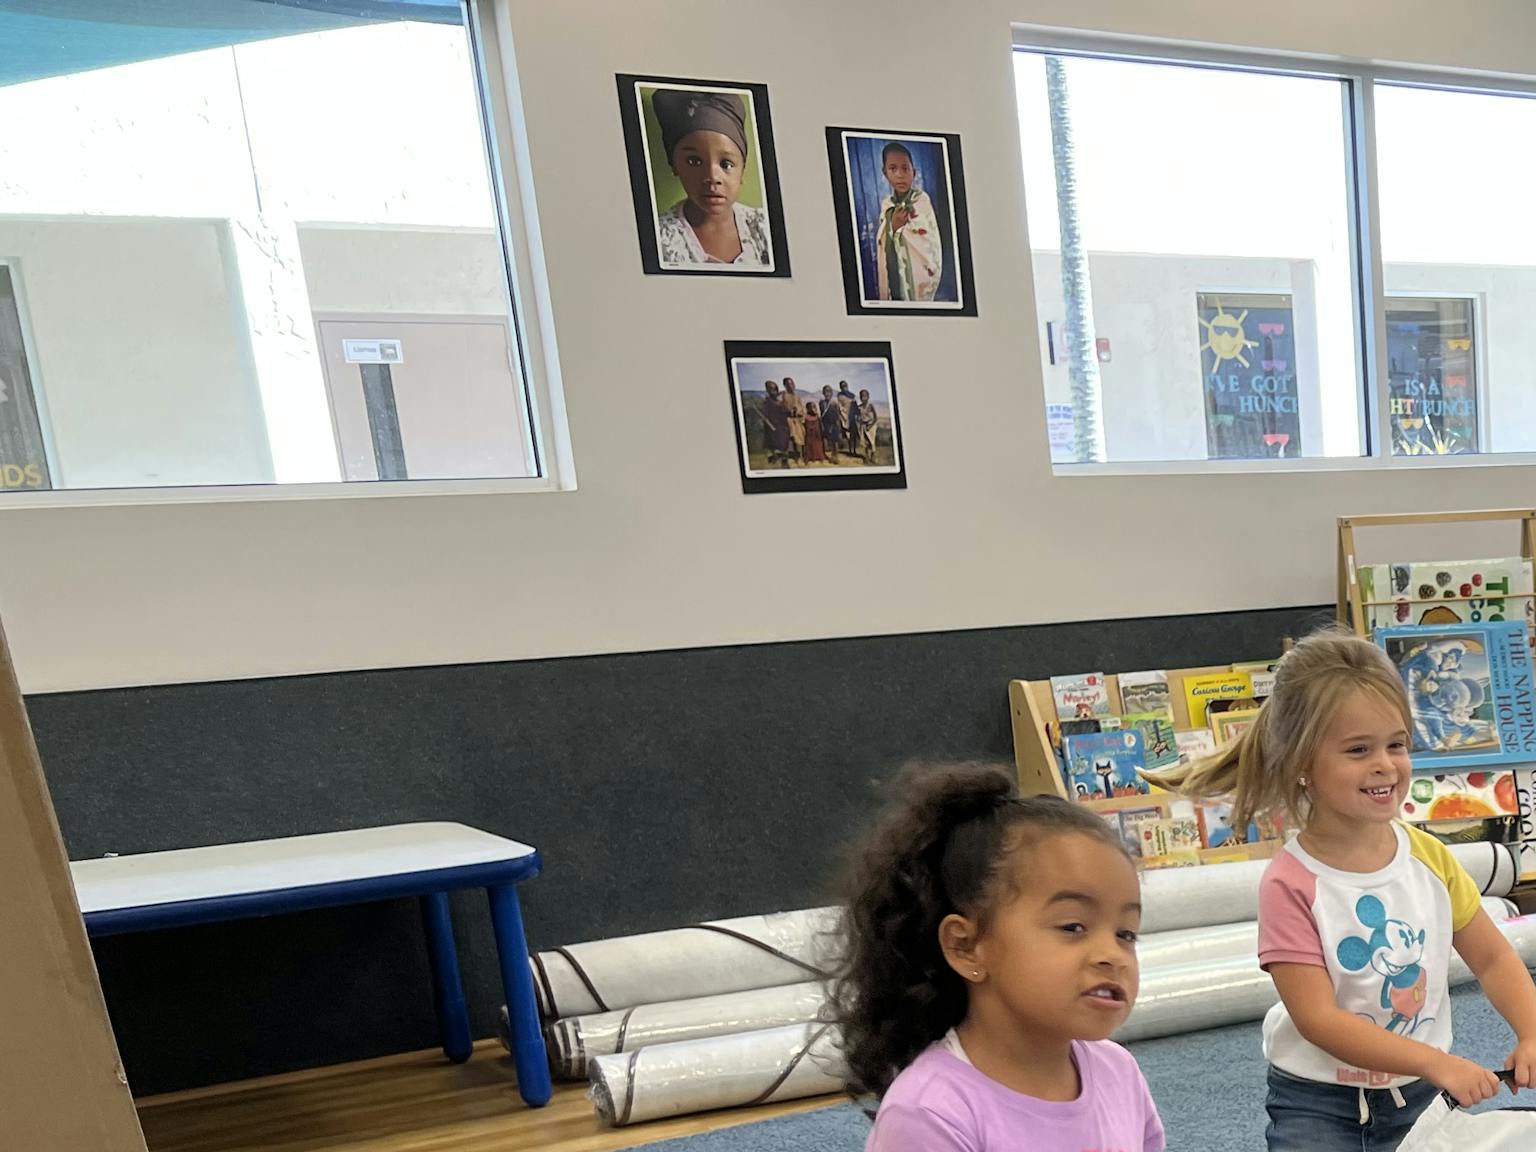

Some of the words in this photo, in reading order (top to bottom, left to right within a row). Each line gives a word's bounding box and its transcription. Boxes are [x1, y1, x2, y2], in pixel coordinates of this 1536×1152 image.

[1251, 374, 1293, 393] GOT
[1405, 379, 1420, 395] IS
[1428, 376, 1441, 395] A
[1508, 629, 1527, 668] THE
[1497, 695, 1520, 753] HOUSE
